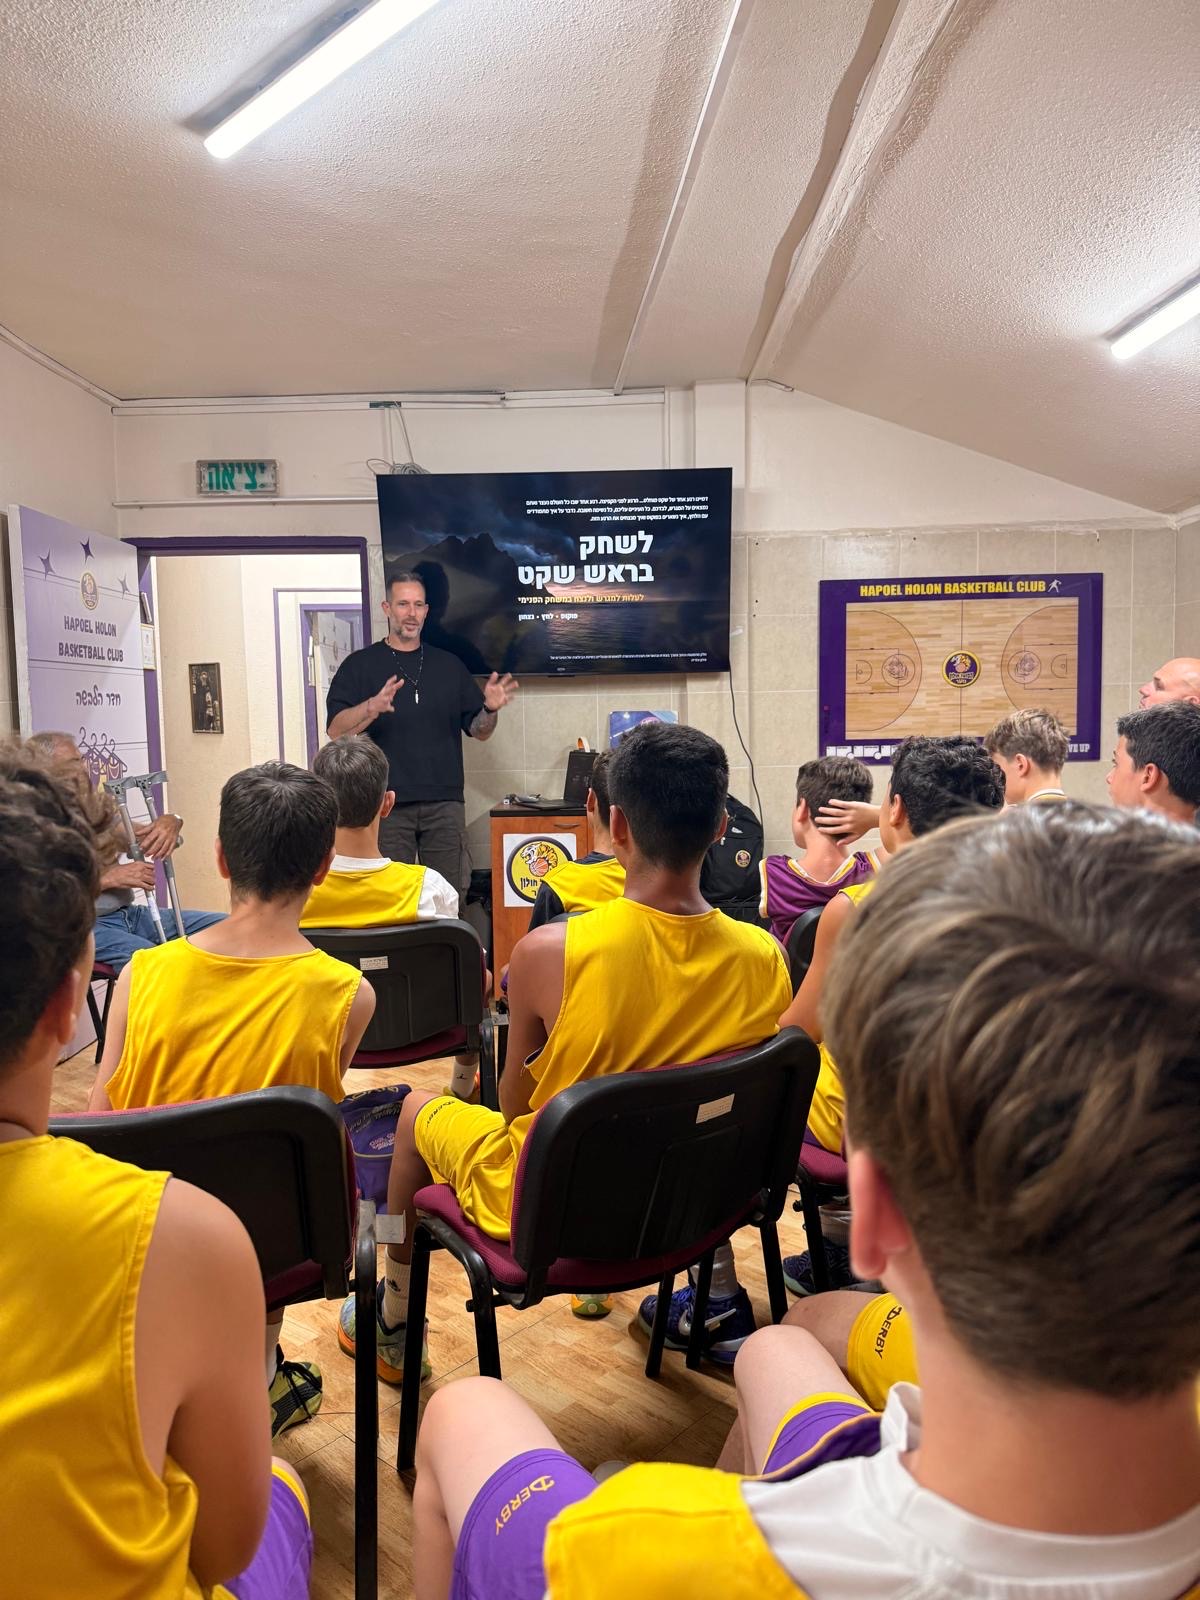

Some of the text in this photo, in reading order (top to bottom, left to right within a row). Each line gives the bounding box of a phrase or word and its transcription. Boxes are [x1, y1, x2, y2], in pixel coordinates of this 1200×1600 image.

[207, 463, 266, 490] יציאה
[580, 530, 654, 560] לשחק
[518, 564, 654, 590] בראש שקט
[860, 581, 1046, 596] HAPOEL HOLON BASKETBALL CLUB
[544, 596, 572, 604] במשחק
[573, 594, 594, 603] ולנצח
[596, 594, 620, 602] למגרש
[622, 594, 644, 602] לעלות
[541, 612, 554, 621] לחץ
[64, 616, 116, 637] HAPOEL HOLON
[58, 642, 124, 662] BASKETBALL CLUB
[76, 684, 121, 706] חדר הלבשה
[1079, 744, 1090, 752] UP
[520, 877, 538, 890] חולון
[874, 1306, 902, 1360] DERBY
[496, 1476, 555, 1536] DERBY
